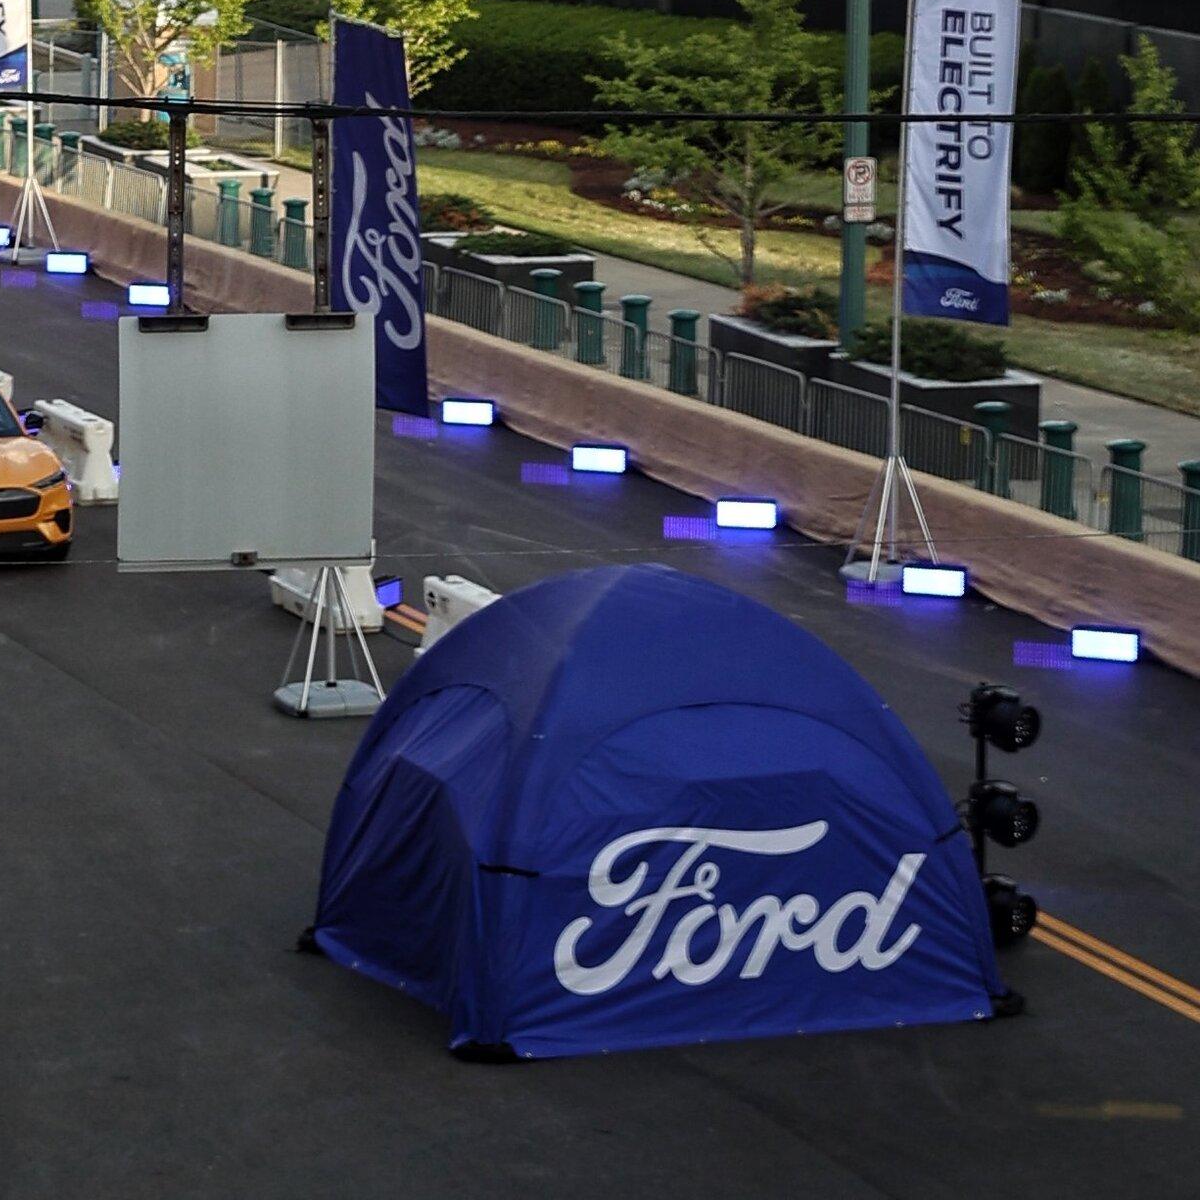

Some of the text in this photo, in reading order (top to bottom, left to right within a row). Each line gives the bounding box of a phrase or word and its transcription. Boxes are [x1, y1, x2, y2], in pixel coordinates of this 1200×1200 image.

[934, 8, 966, 239] ELECTRIFY
[967, 10, 996, 161] BUILT TO
[341, 91, 423, 350] Ford
[939, 287, 979, 312] Ford
[552, 818, 929, 997] Ford
